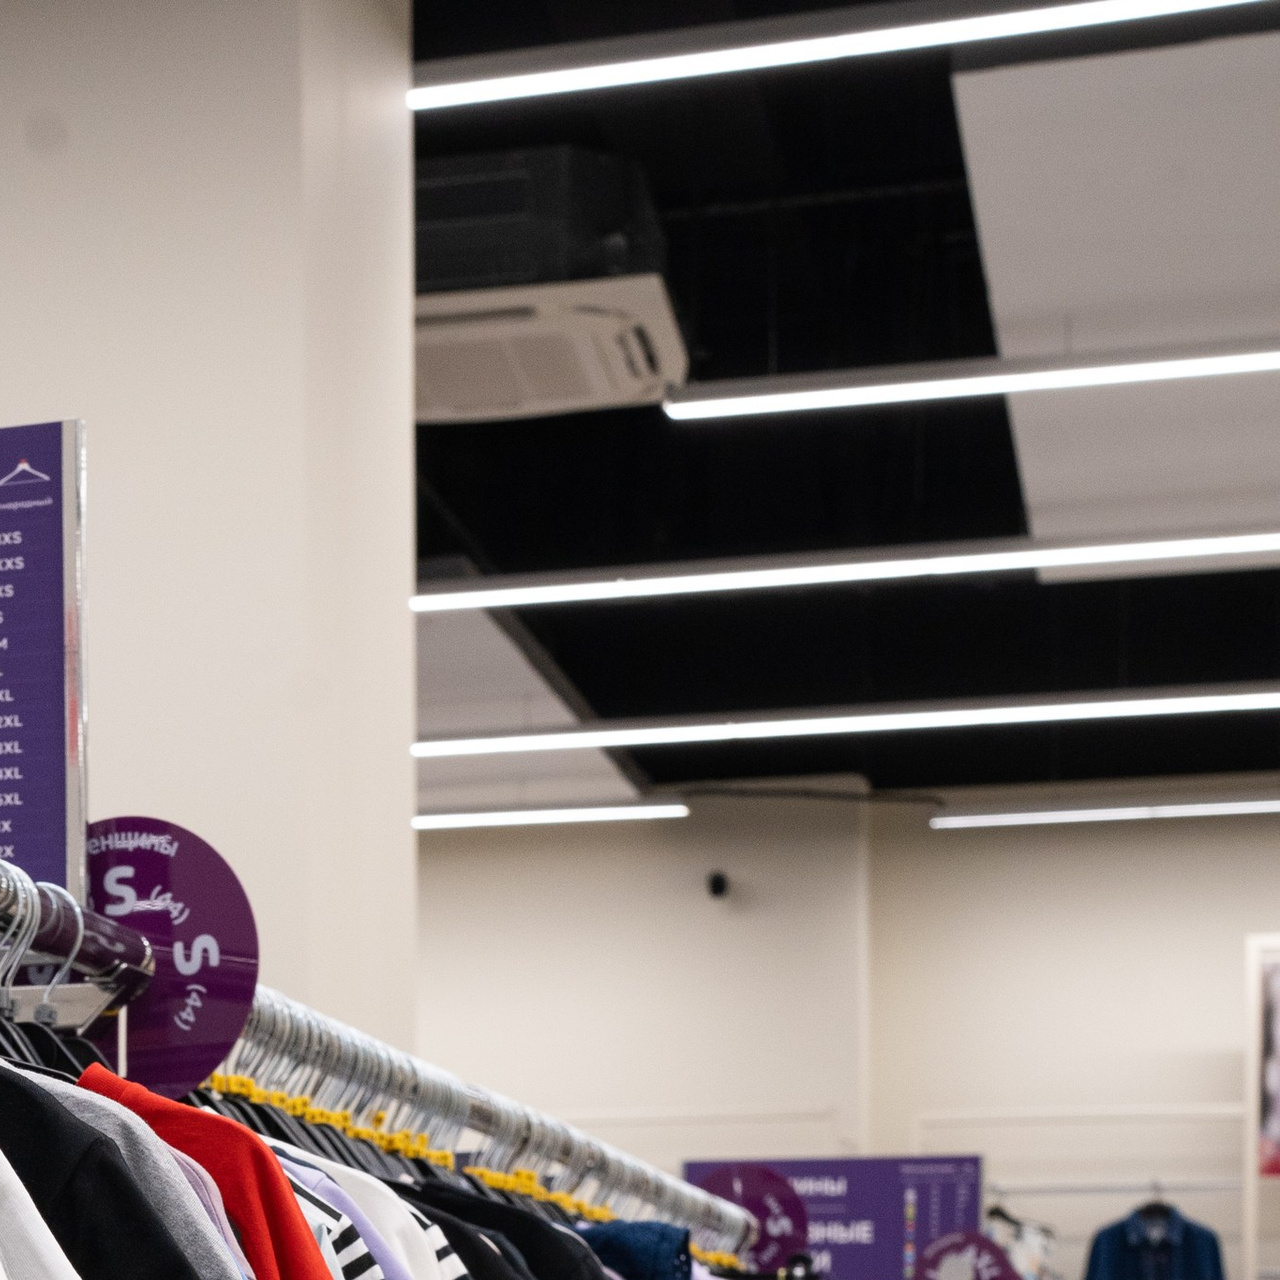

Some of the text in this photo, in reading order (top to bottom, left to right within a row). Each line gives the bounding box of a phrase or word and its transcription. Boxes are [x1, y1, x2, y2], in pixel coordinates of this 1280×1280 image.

[103, 864, 138, 917] S
[173, 934, 220, 976] S
[173, 984, 208, 1031] (44)
